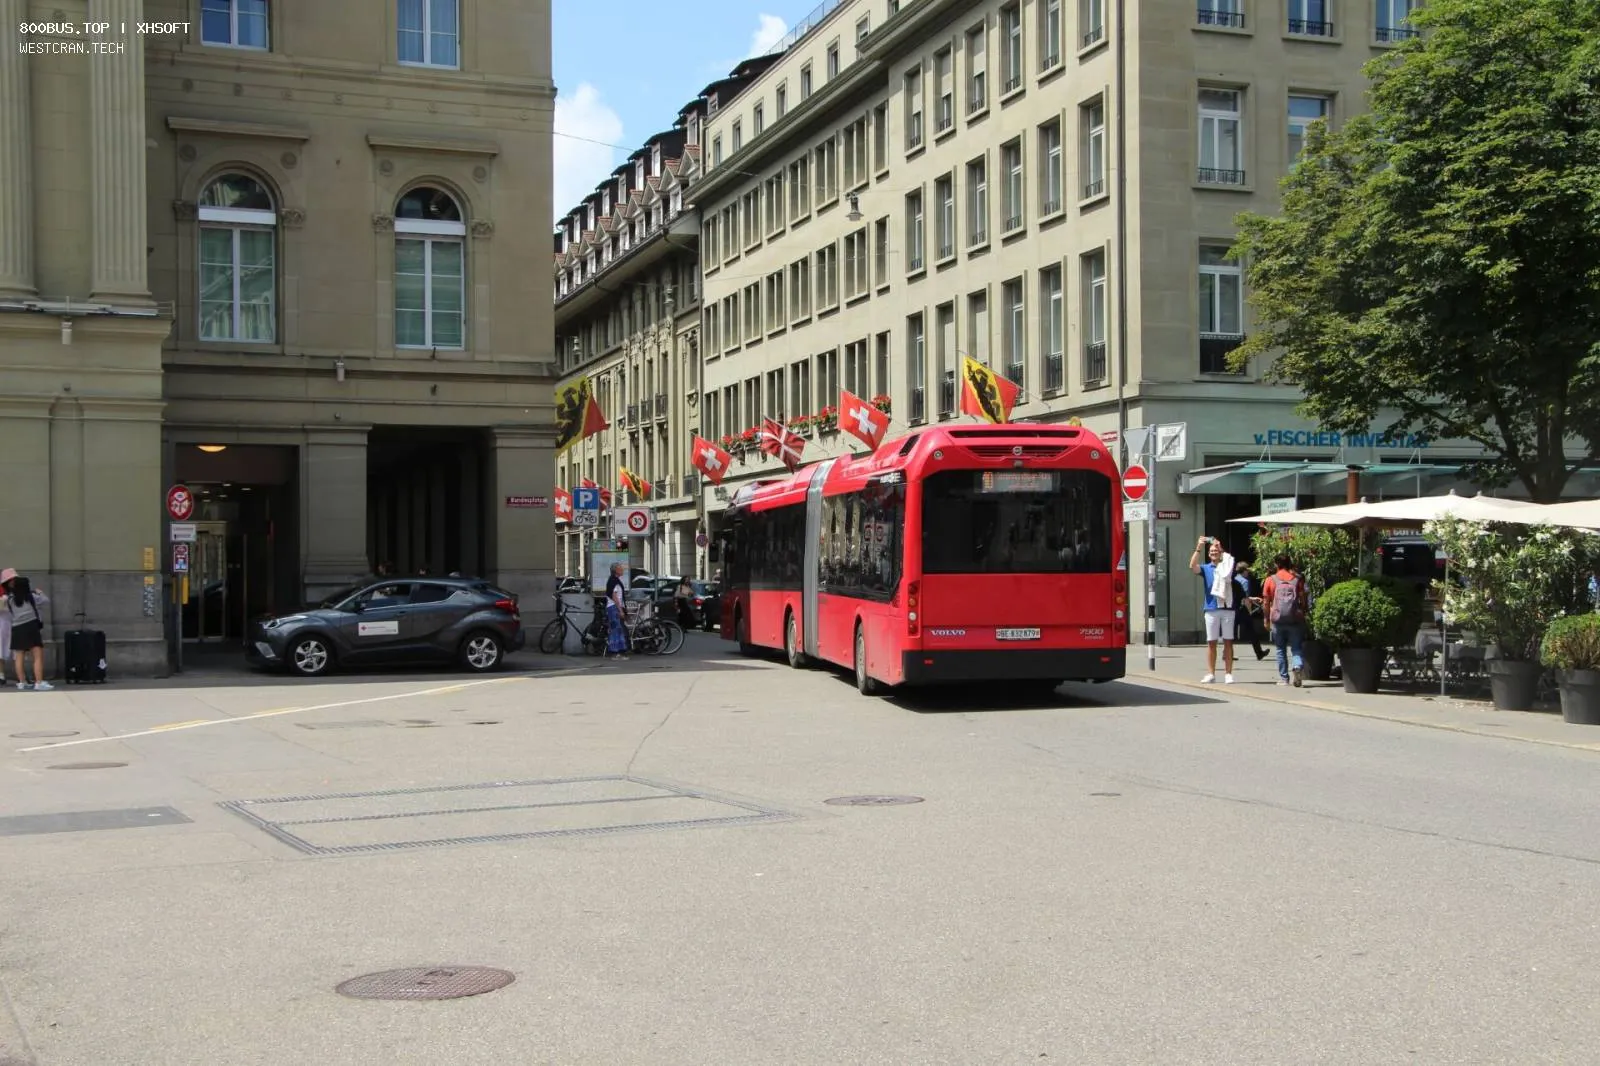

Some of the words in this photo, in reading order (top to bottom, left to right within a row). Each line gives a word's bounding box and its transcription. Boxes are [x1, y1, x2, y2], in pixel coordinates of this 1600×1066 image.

[1254, 429, 1341, 447] v.FISCHER
[579, 491, 593, 508] P
[632, 517, 643, 527] 30
[930, 629, 966, 637] VOLVO
